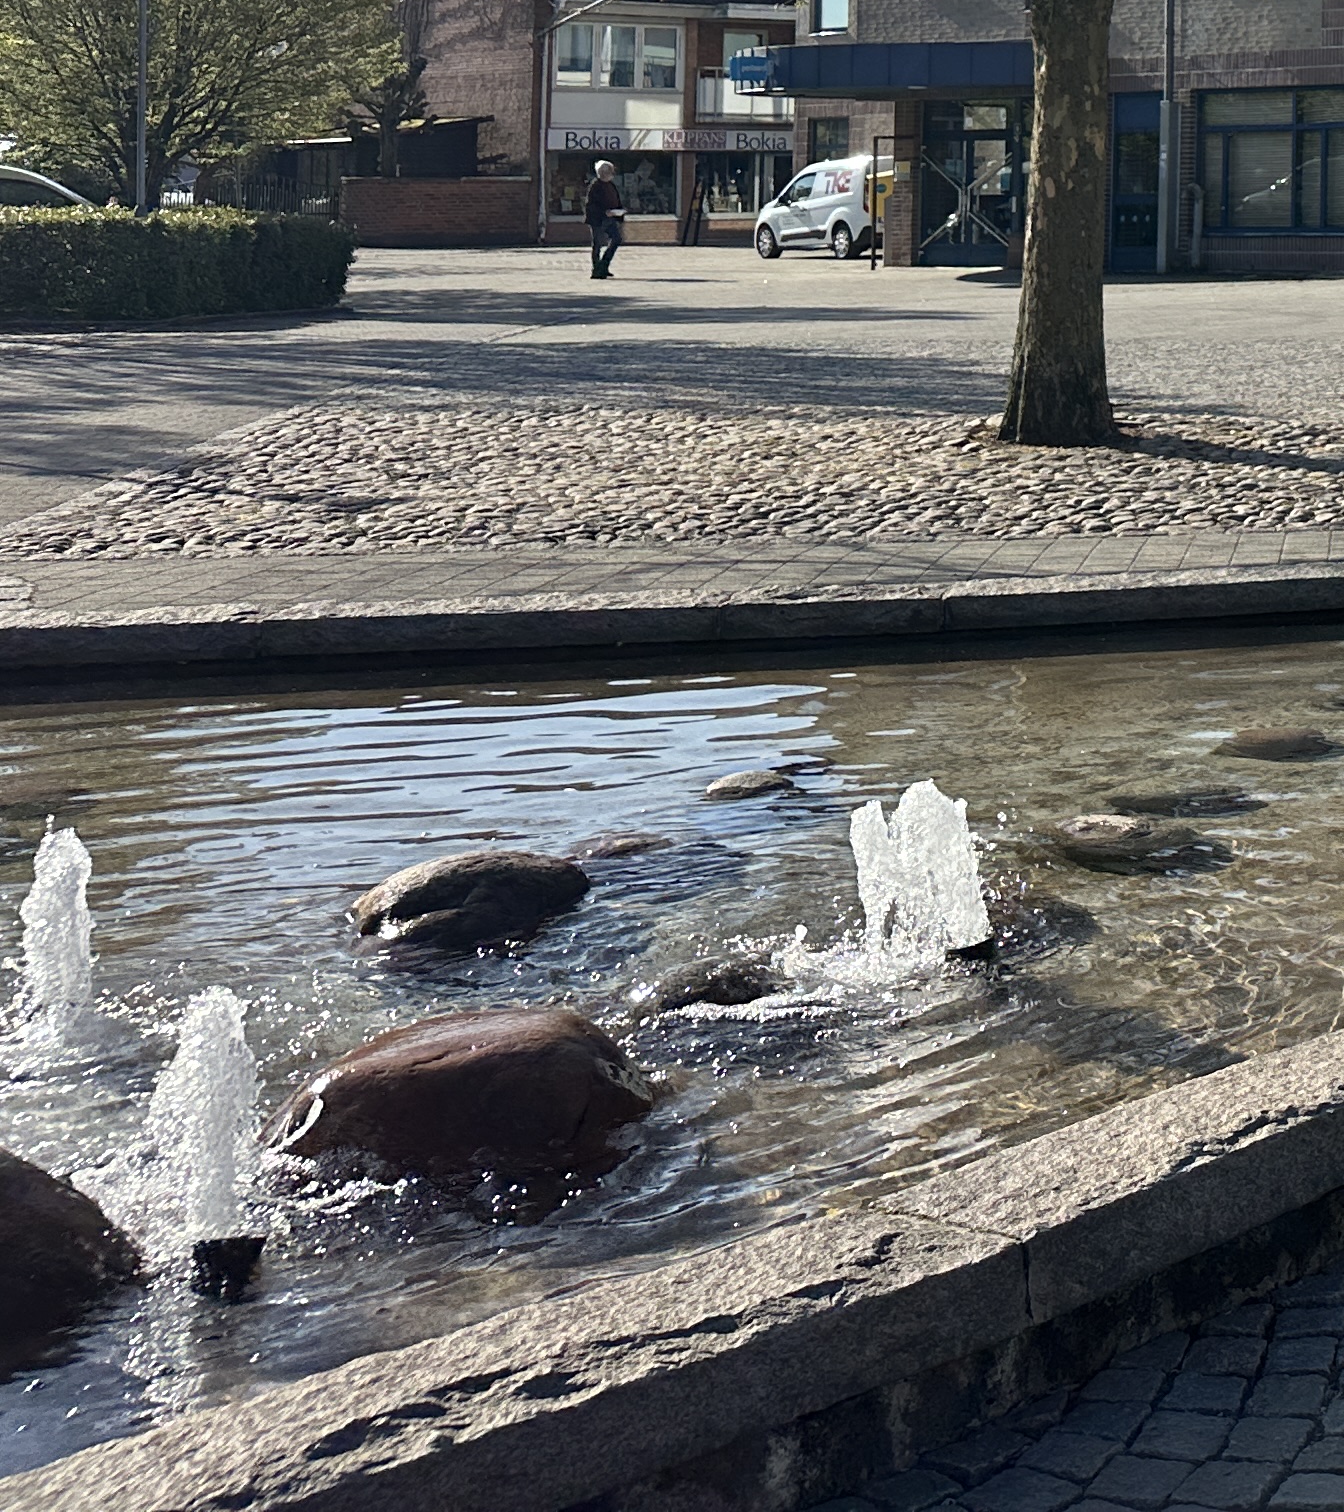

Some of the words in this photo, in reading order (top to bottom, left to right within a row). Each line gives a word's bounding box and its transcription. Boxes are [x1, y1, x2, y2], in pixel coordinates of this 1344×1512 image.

[564, 131, 621, 150] Bokia
[664, 131, 726, 143] KLIPPANS
[736, 132, 787, 150] Bokia
